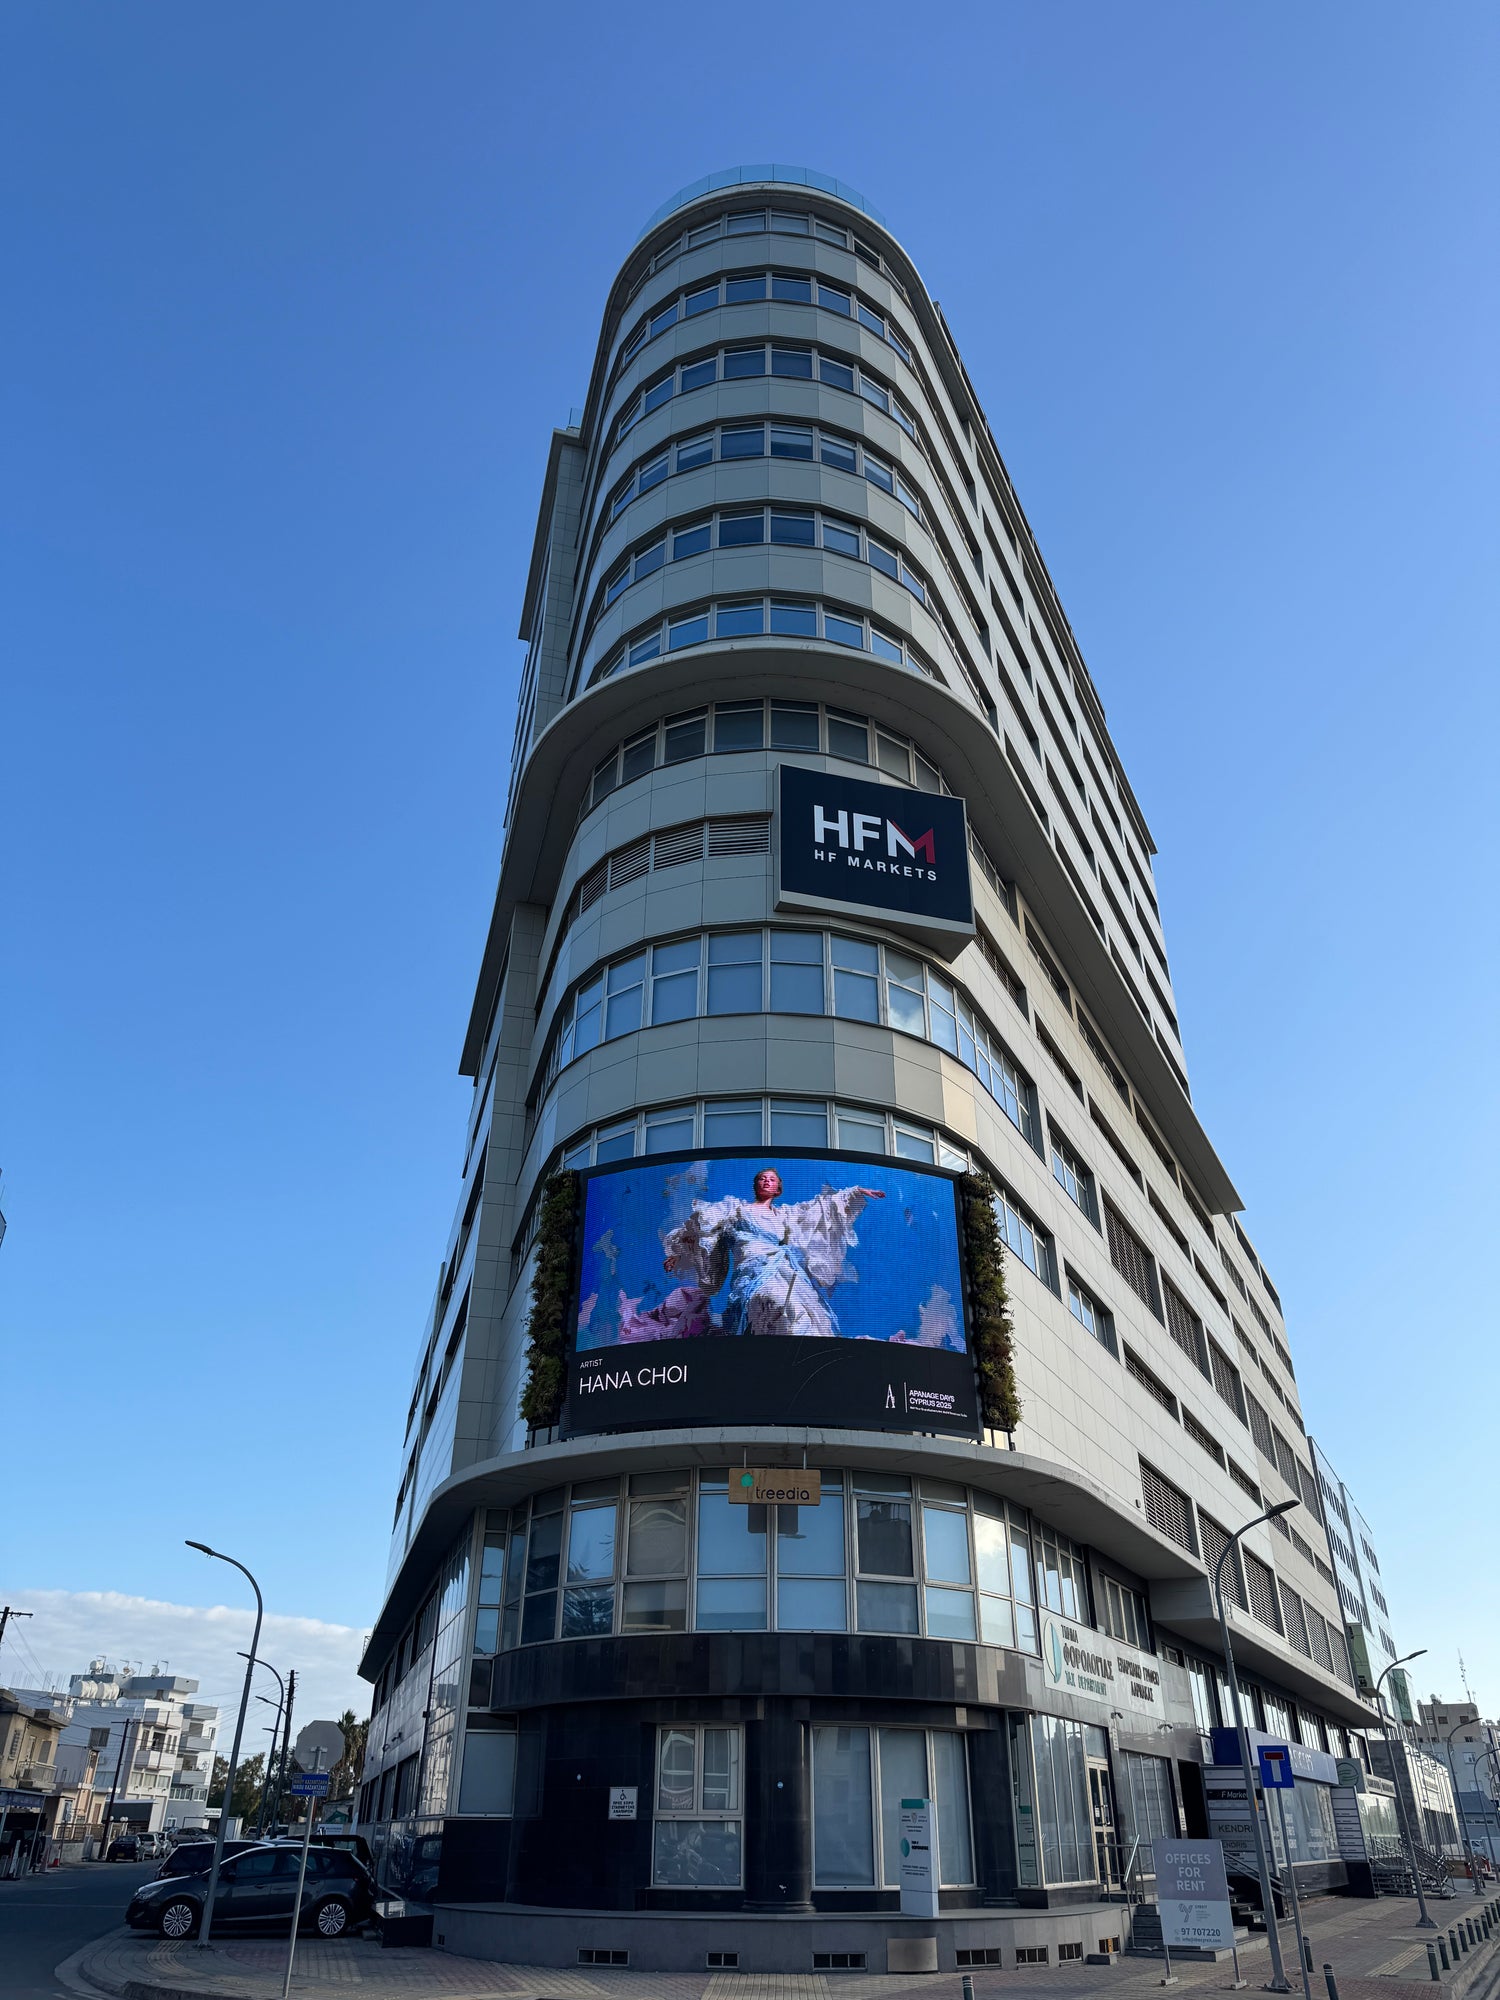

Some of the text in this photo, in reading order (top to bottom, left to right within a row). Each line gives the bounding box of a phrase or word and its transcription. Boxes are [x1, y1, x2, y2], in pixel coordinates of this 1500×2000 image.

[814, 804, 936, 864] HFM
[814, 849, 937, 881] HF MARKETS
[580, 1358, 603, 1369] ARTIST
[579, 1364, 688, 1395] HANA CHOI
[909, 1389, 955, 1402] APANAGE DAYS
[909, 1398, 953, 1410] CYPRUS 2025
[755, 1486, 810, 1500] treedia
[1063, 1643, 1114, 1681] ΦΟΡΟΛΟΓΙΑΣ
[1226, 1790, 1249, 1799] Marke
[1218, 1824, 1253, 1833] KENDRI
[1165, 1853, 1211, 1865] OFFICES
[1178, 1866, 1201, 1878] FOR
[1176, 1880, 1205, 1891] RENT
[1181, 1927, 1221, 1937] 97 707220
